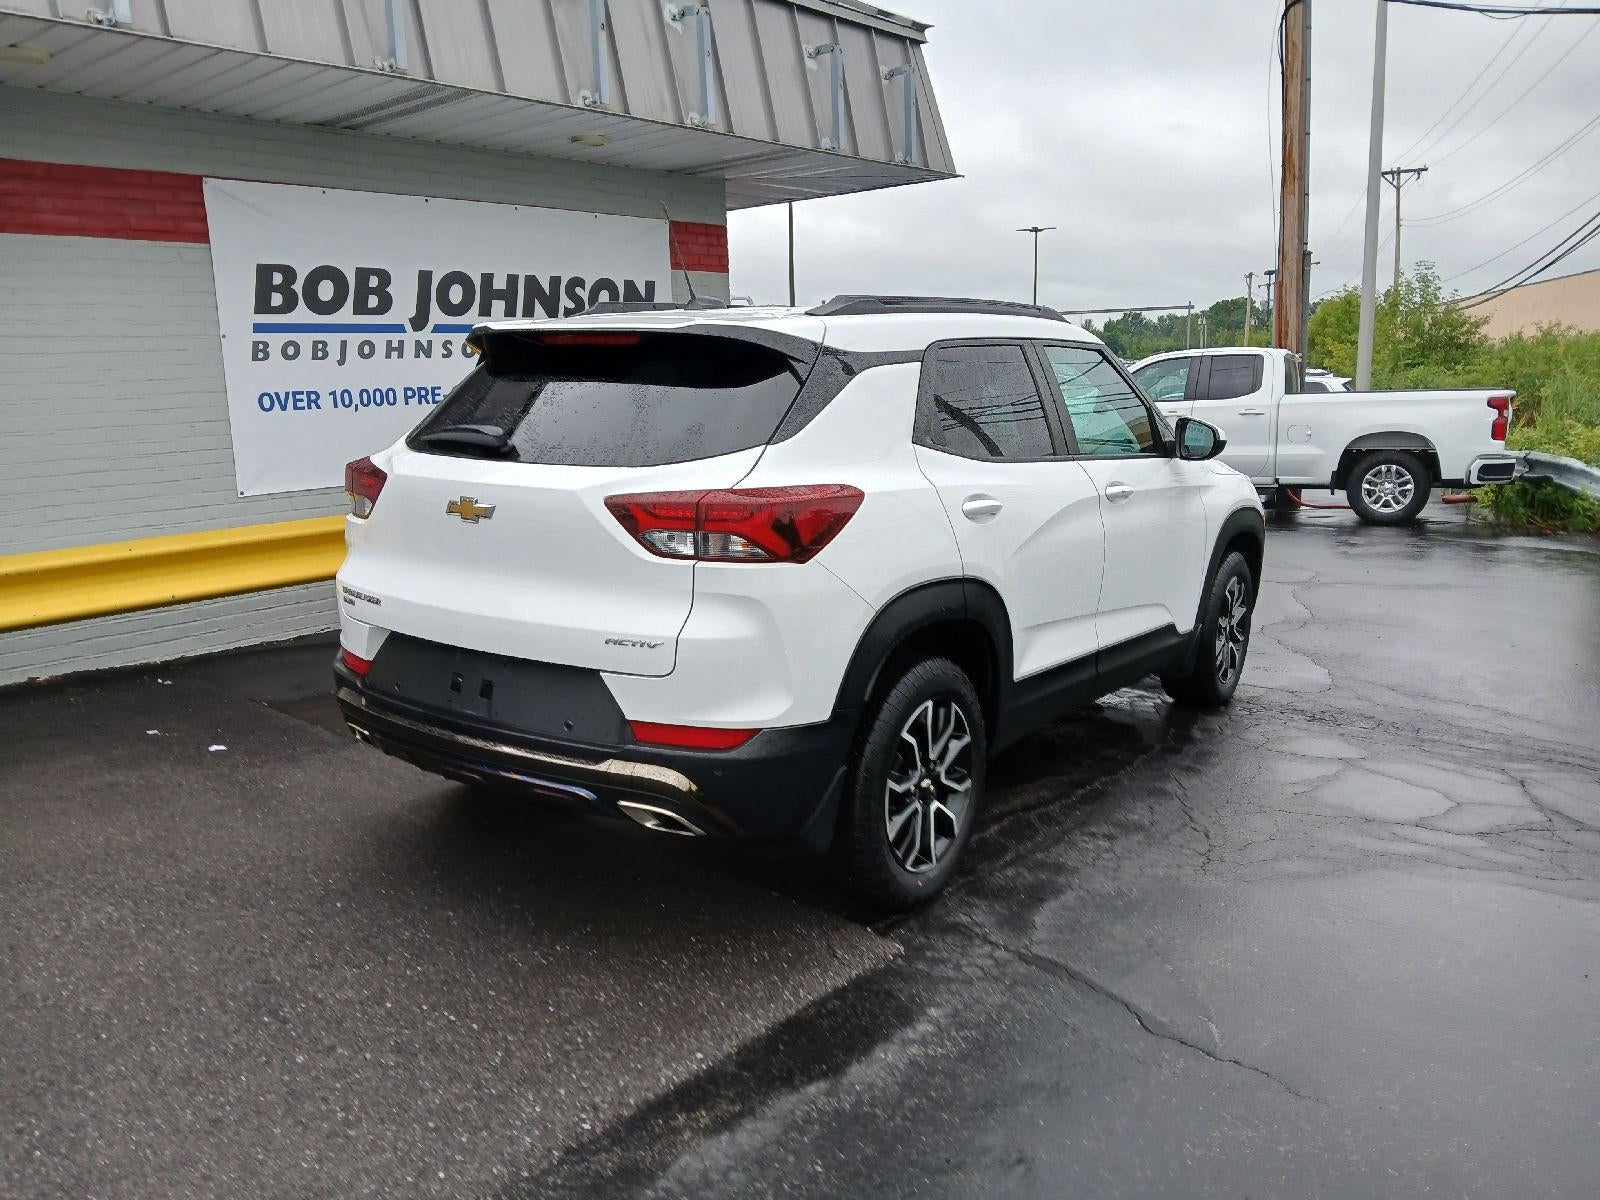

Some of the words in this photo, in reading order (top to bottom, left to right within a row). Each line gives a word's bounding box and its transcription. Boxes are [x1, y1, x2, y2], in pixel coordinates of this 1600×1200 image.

[254, 263, 394, 316] BOB
[408, 269, 656, 332] JOHNSON
[257, 390, 322, 413] OVER
[328, 388, 398, 413] 10,000
[604, 637, 664, 649] ACTIV
